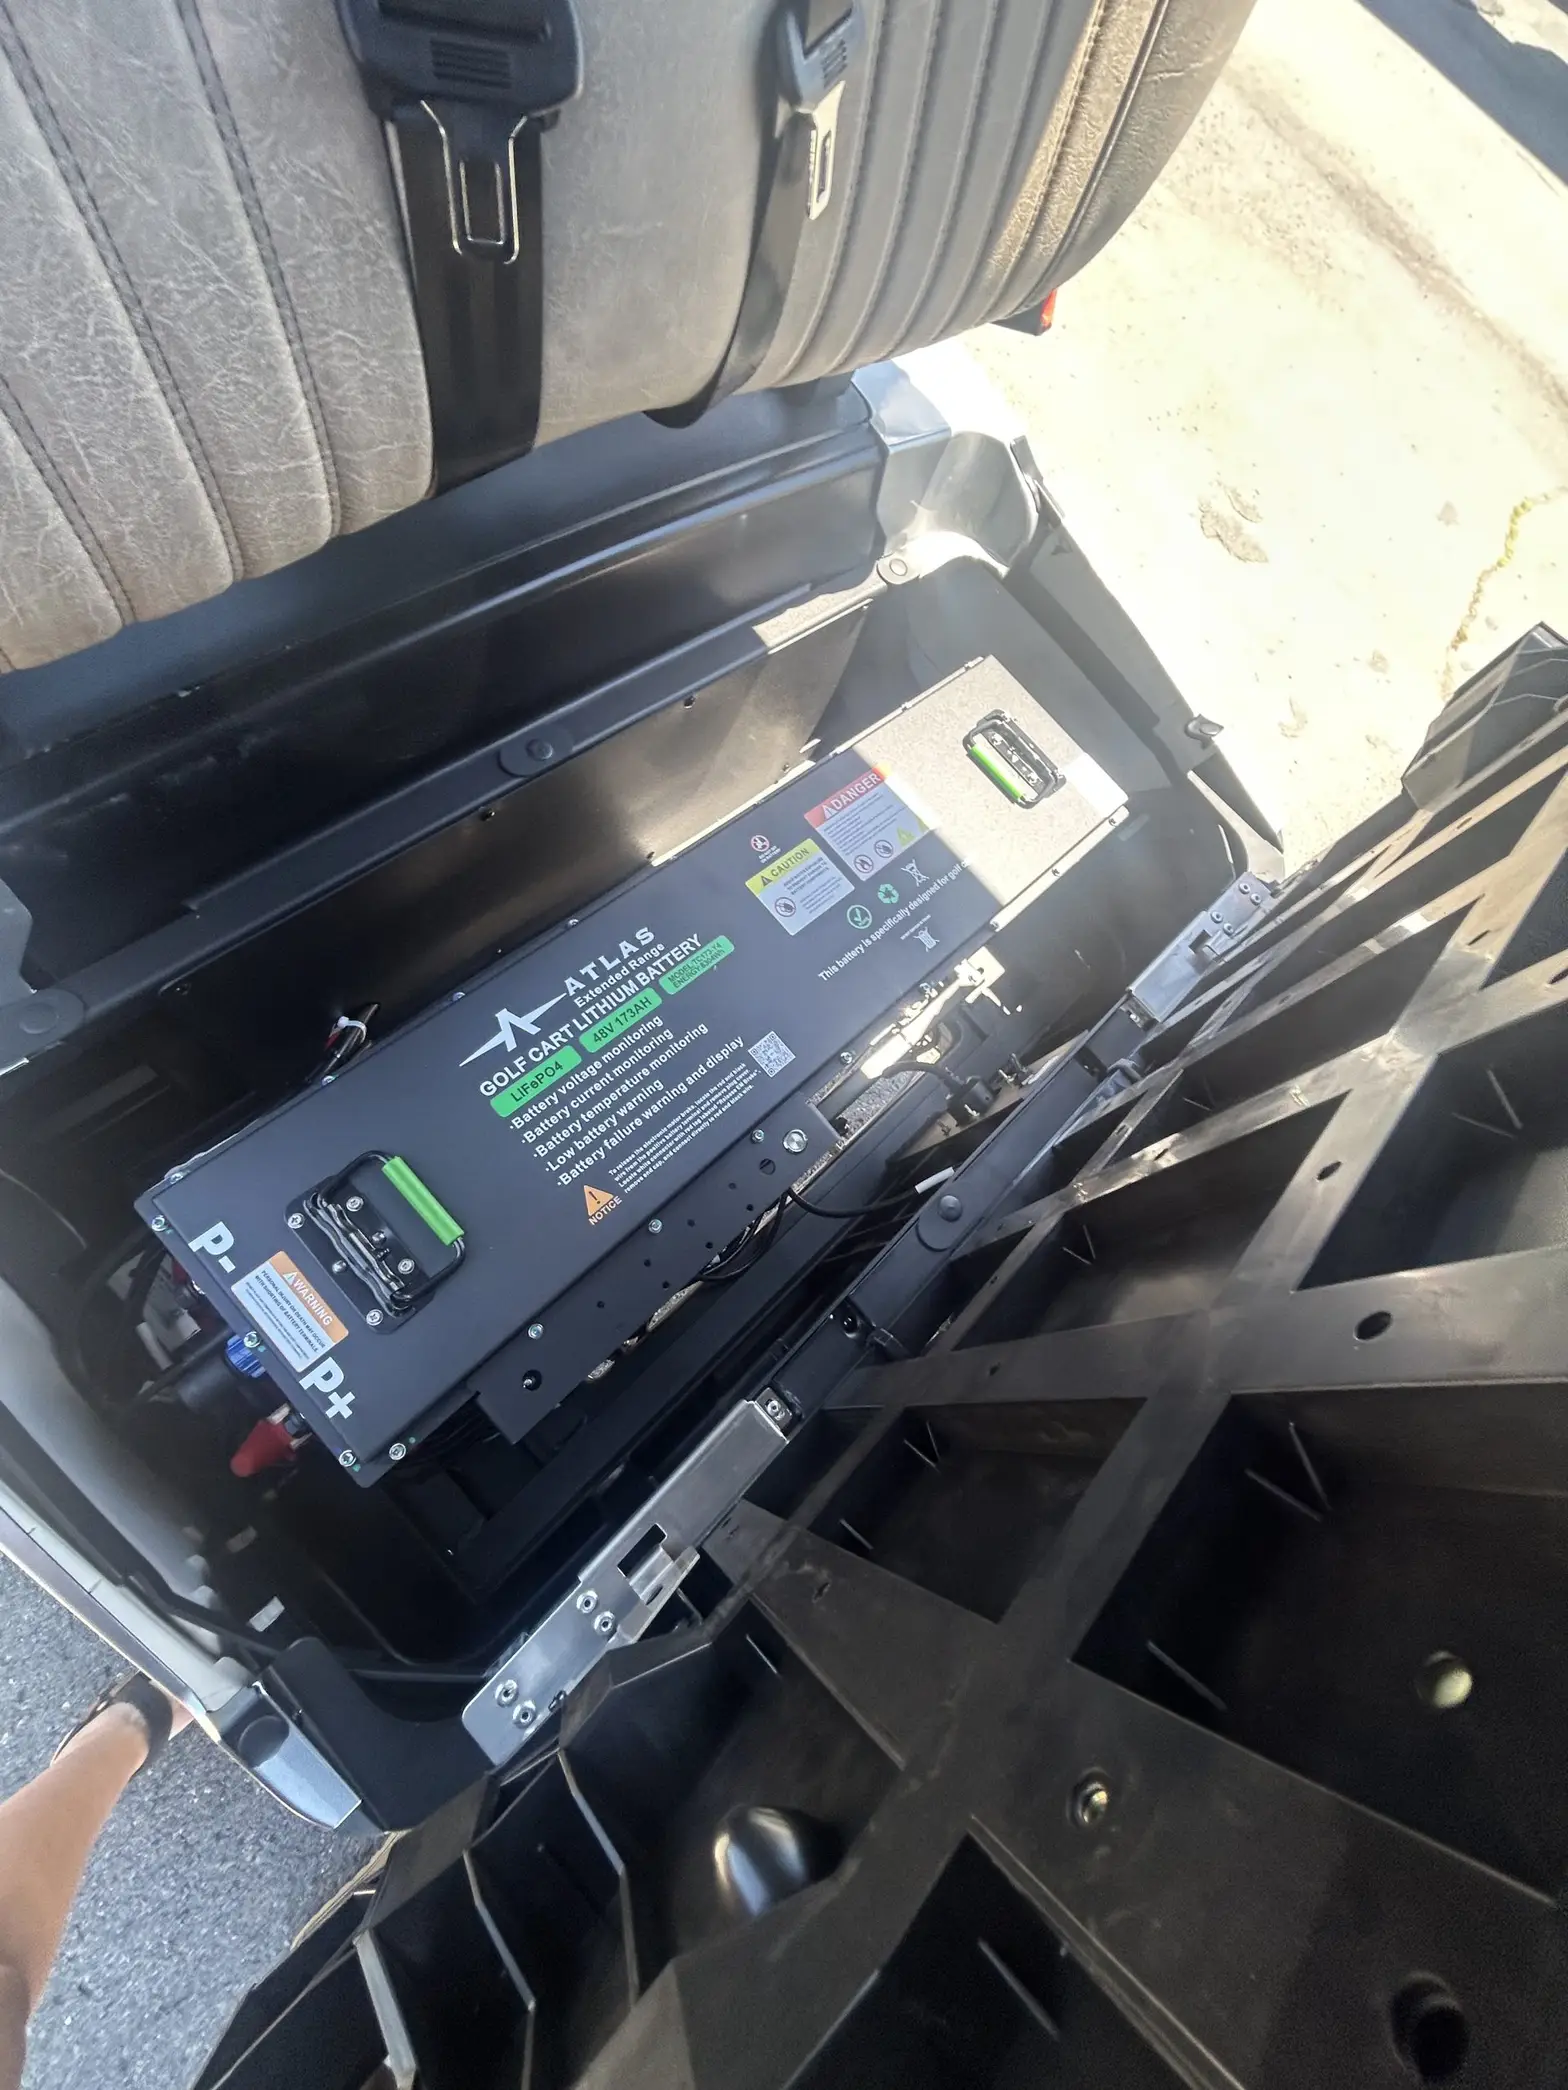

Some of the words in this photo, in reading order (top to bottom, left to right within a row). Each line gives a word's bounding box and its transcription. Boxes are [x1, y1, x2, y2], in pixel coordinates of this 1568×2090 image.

[829, 770, 881, 810] DANGER
[770, 847, 810, 877] CAUTION
[818, 965, 839, 981] This
[835, 944, 865, 968] battery
[861, 938, 872, 947] is
[870, 907, 911, 941] specifically
[908, 882, 941, 910] designed
[936, 875, 950, 886] for
[947, 863, 962, 880] golf
[564, 927, 654, 996] ATLAS
[573, 965, 630, 1008] Extended
[628, 943, 665, 970] Range
[480, 1056, 527, 1096] GOLF
[528, 1023, 574, 1062] CART
[572, 979, 639, 1031] LITHIUM
[635, 933, 701, 986] BATTERY
[593, 1022, 614, 1043] 48V
[615, 996, 652, 1026] 173AH
[511, 1092, 559, 1129] Battery
[557, 1061, 603, 1094] voltage
[601, 1016, 663, 1063] monitoring
[523, 1106, 570, 1143] Battery
[570, 1072, 614, 1108] current
[612, 1029, 674, 1077] monitoring
[535, 1119, 582, 1157] Battery
[580, 1068, 650, 1122] temperature
[649, 1023, 708, 1070] monitoring
[547, 1147, 575, 1171] Low
[573, 1114, 618, 1150] battery
[616, 1079, 664, 1117] warning
[558, 1147, 605, 1185] Battery
[603, 1118, 643, 1150] failure
[641, 1082, 688, 1119] warning
[686, 1064, 708, 1085] and
[706, 1036, 744, 1068] display
[588, 1195, 622, 1225] NOTICE
[188, 1221, 236, 1273] P-
[294, 1278, 333, 1326] WARNING
[299, 1357, 356, 1419] P+
